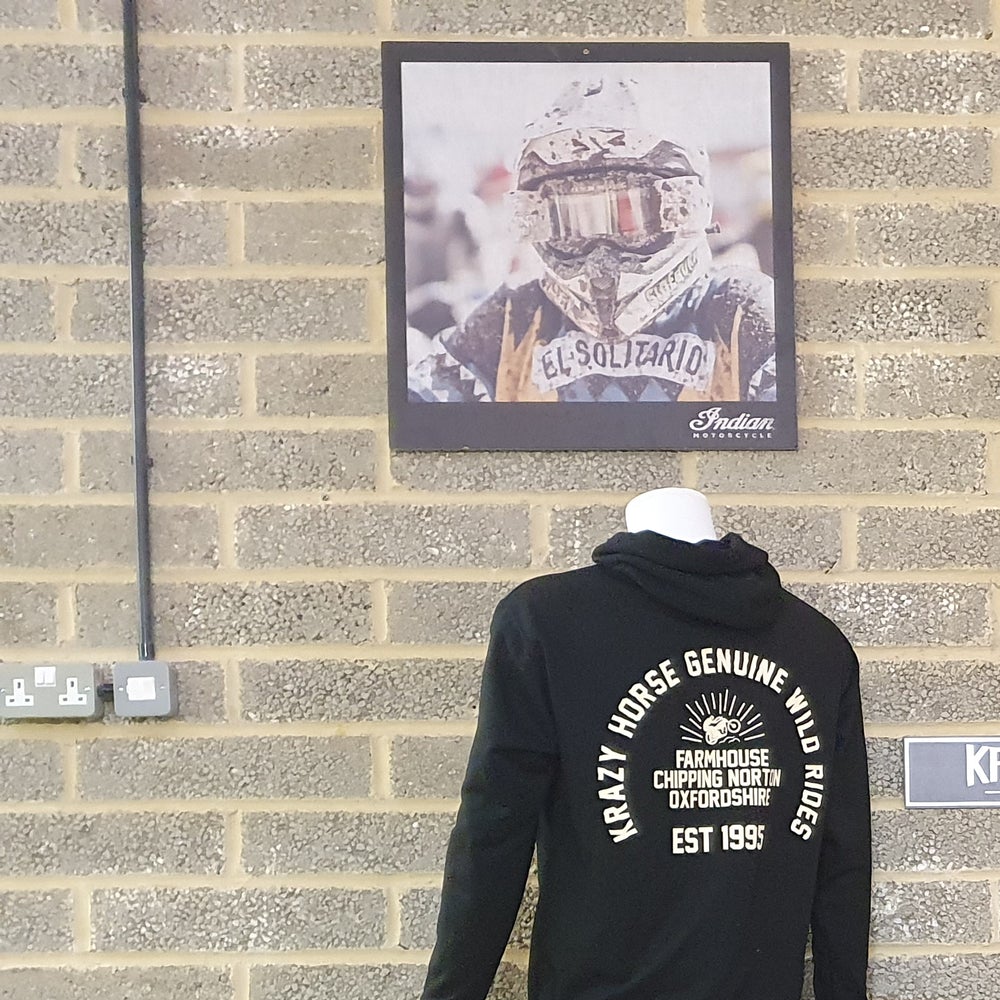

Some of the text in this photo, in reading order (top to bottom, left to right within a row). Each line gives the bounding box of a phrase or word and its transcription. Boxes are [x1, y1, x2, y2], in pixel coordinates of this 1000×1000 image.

[542, 339, 703, 380] EL SOLITARIO
[689, 406, 775, 431] Indian
[597, 647, 824, 844] KRAZY HORSE GENUINE WILD RIDES
[675, 748, 770, 769] FARMHOUSE
[653, 768, 782, 790] CHIPPING NORTON
[668, 787, 772, 809] OXFORDSHIRE
[672, 824, 766, 855] EST 1995
